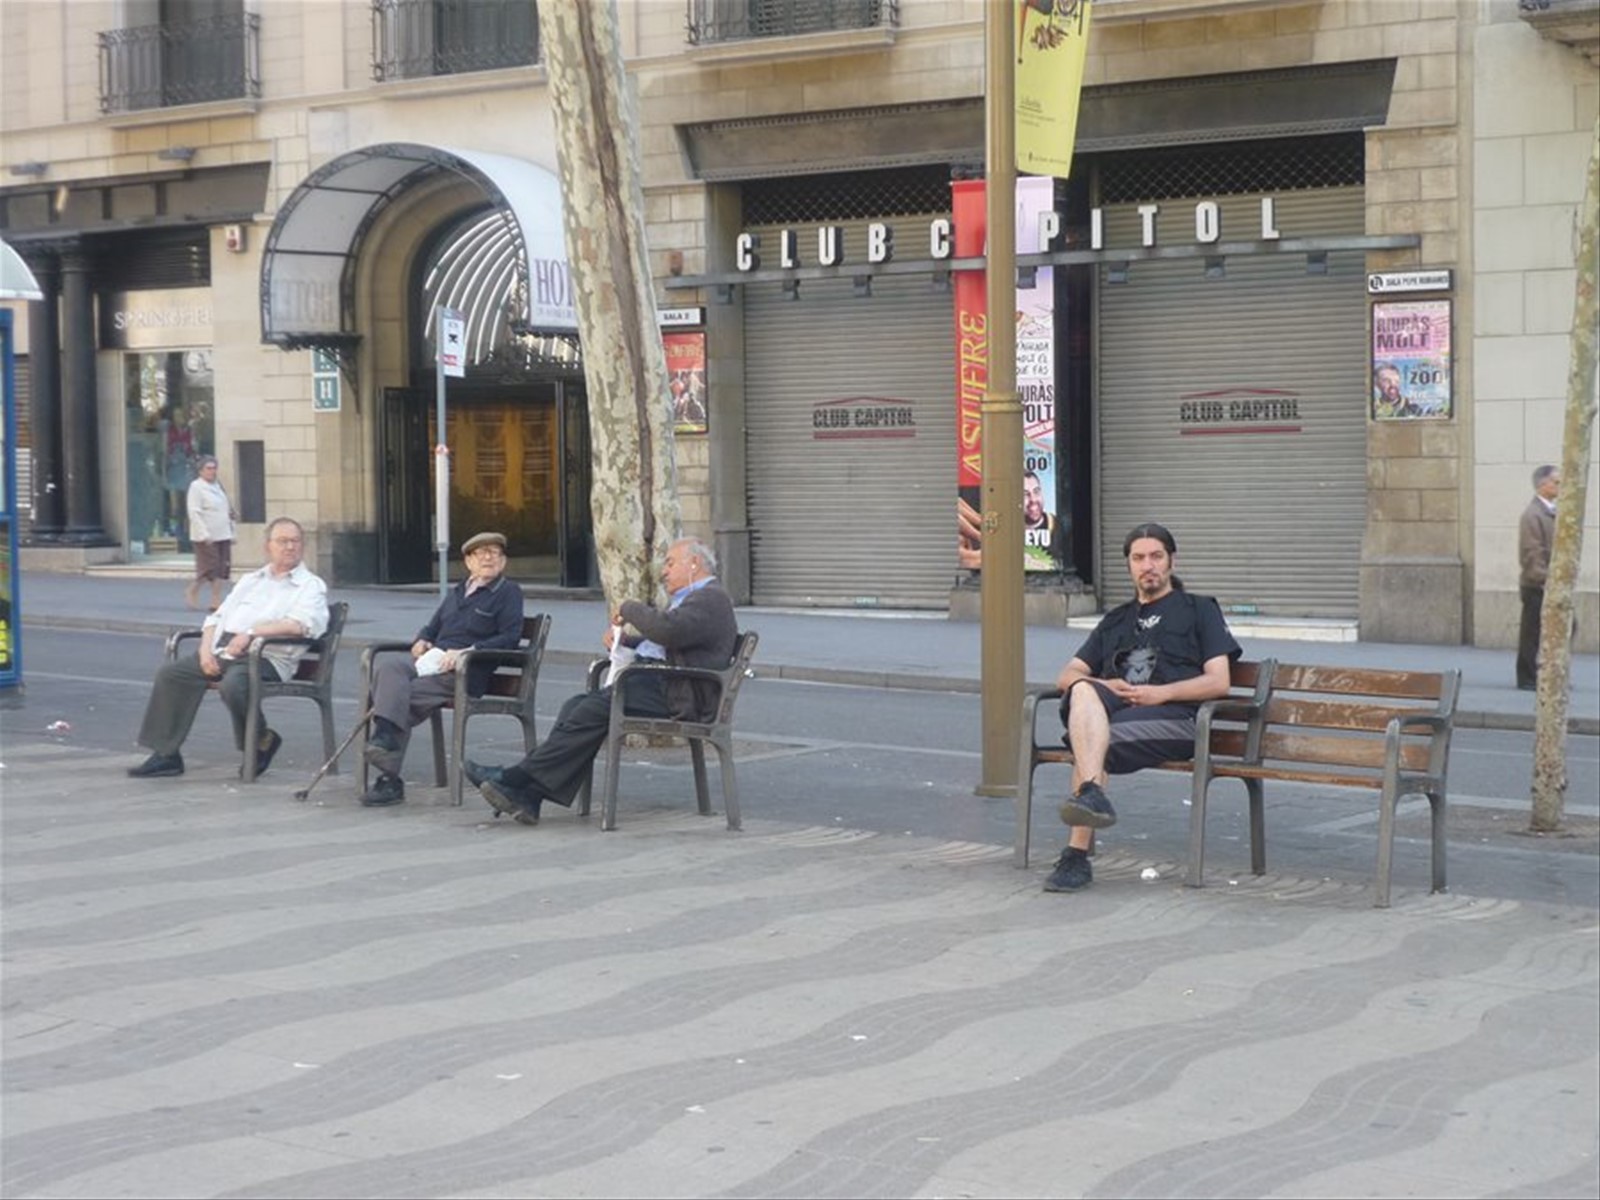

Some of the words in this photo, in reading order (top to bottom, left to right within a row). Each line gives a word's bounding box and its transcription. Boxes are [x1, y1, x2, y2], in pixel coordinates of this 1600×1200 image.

[736, 223, 888, 271] CLUB
[930, 198, 1280, 259] CPITOL
[534, 258, 573, 307] HOT
[663, 312, 682, 321] SALA
[1018, 379, 1053, 403] URÀS
[813, 408, 850, 428] CLUB
[854, 406, 916, 428] CAPITOL
[1024, 404, 1053, 423] OLT
[1181, 401, 1224, 423] CLUB
[1229, 399, 1302, 422] CAPITOL
[1027, 456, 1048, 471] OO
[1024, 529, 1051, 547] EYU
